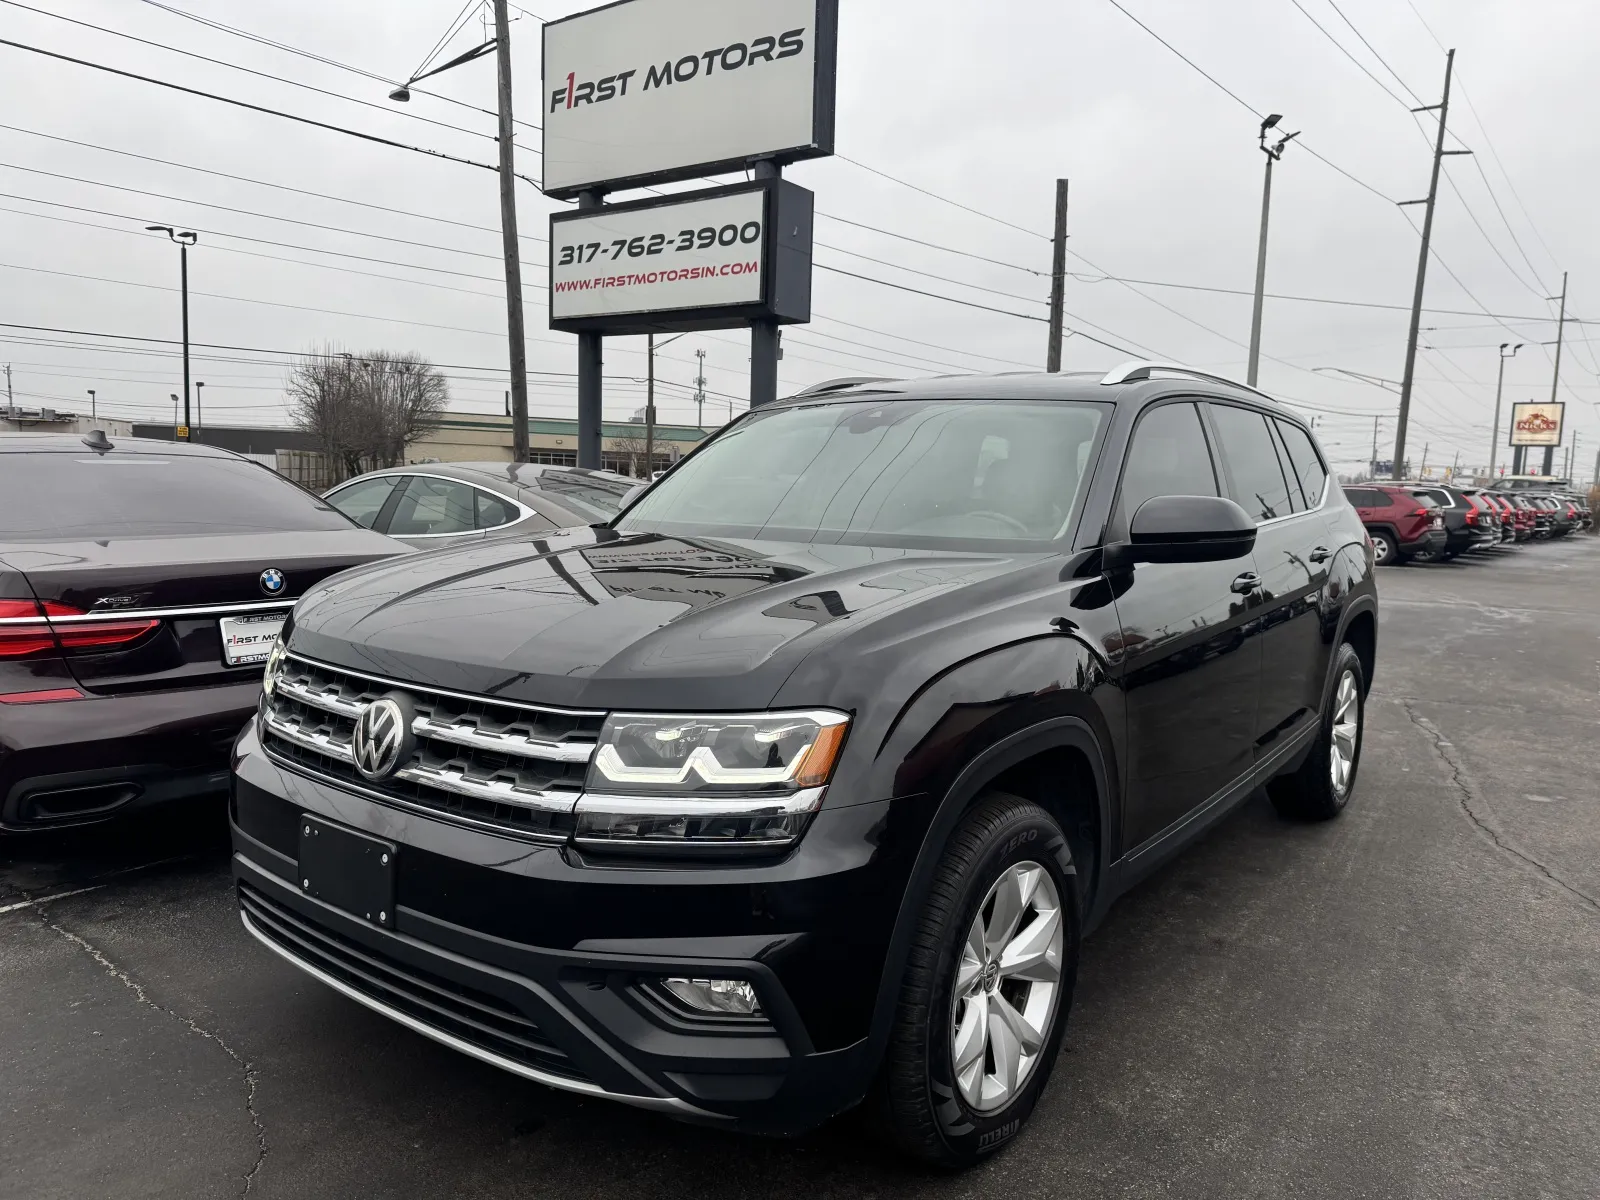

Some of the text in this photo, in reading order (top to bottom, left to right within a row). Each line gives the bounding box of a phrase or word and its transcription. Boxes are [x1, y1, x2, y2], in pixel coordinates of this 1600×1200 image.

[642, 27, 806, 91] MOTORS
[558, 221, 761, 266] 317-762-3900
[555, 261, 758, 293] WWW.FIRSTMOTORSIN.COM
